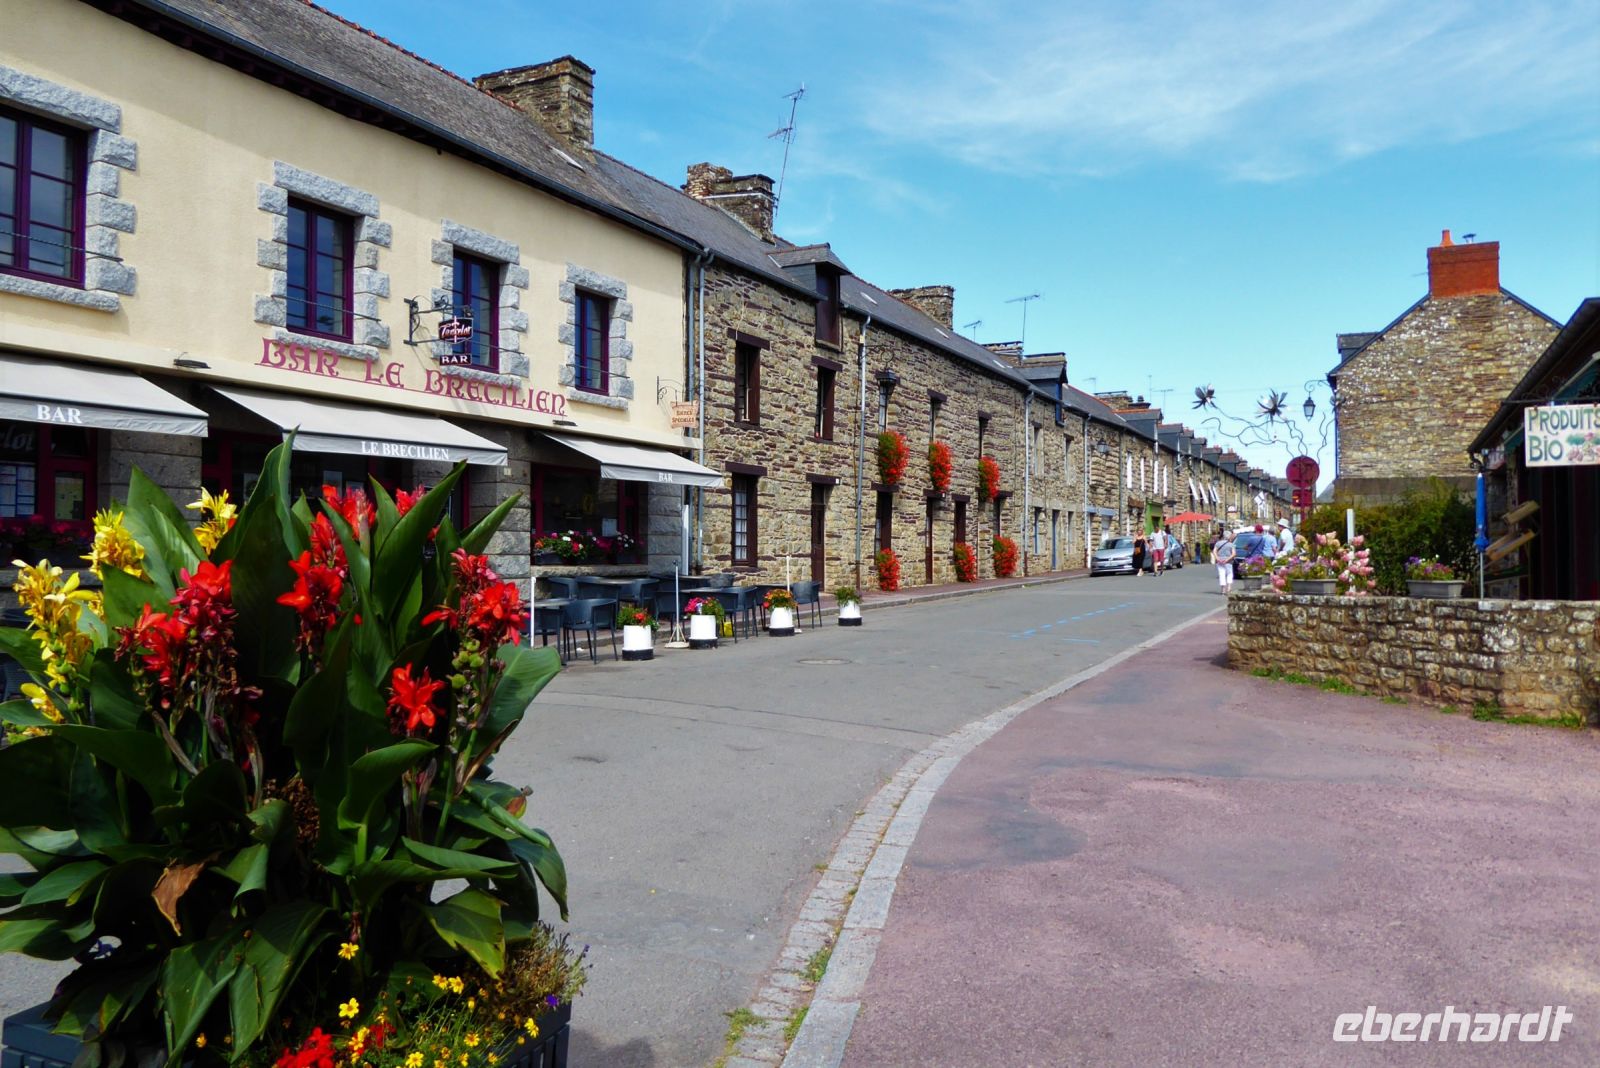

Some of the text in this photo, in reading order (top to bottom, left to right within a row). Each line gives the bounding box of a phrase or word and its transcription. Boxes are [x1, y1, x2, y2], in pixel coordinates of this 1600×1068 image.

[441, 355, 468, 364] BAR
[262, 338, 567, 415] BAR LE BRECILIEN
[37, 405, 82, 423] BAR
[361, 441, 449, 460] LE BRECILIEN
[658, 472, 673, 483] BAR
